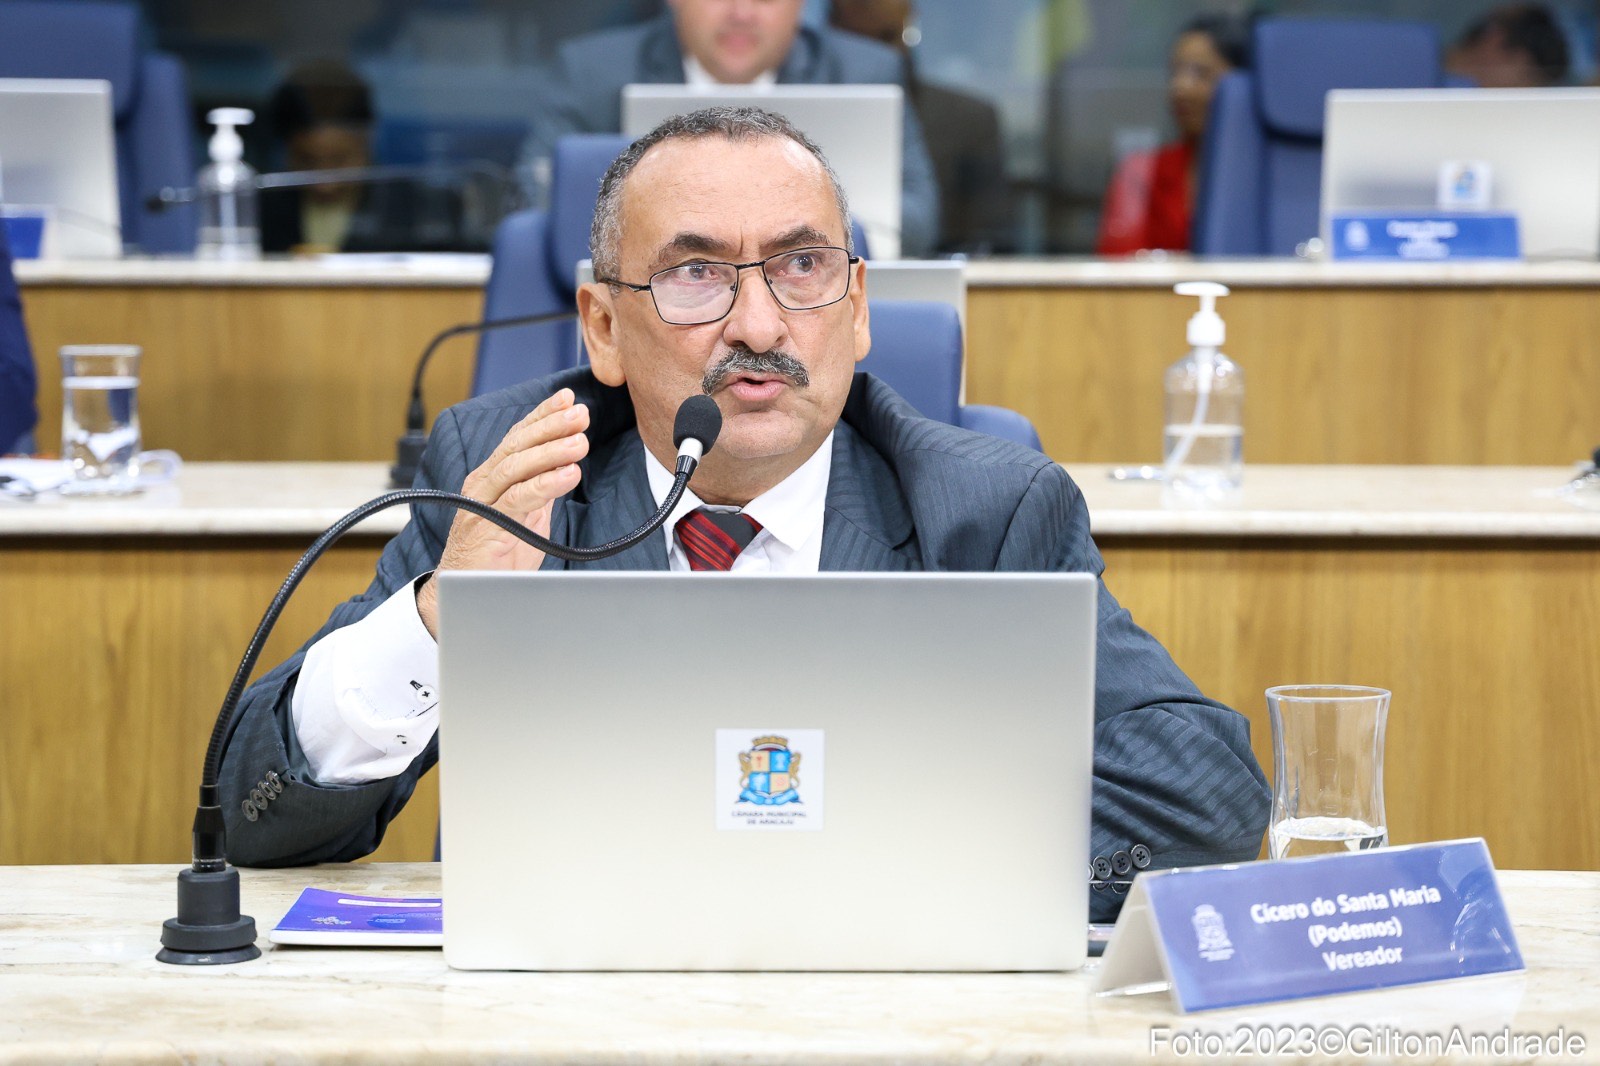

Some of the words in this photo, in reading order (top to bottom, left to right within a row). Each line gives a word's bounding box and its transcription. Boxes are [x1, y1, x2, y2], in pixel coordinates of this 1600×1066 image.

[1250, 902, 1310, 924] Cícero
[1311, 896, 1337, 917] do
[1336, 892, 1390, 914] Santa
[1389, 885, 1442, 908] Maria
[1307, 916, 1403, 948] (Podemos)
[1321, 945, 1403, 972] Vereador
